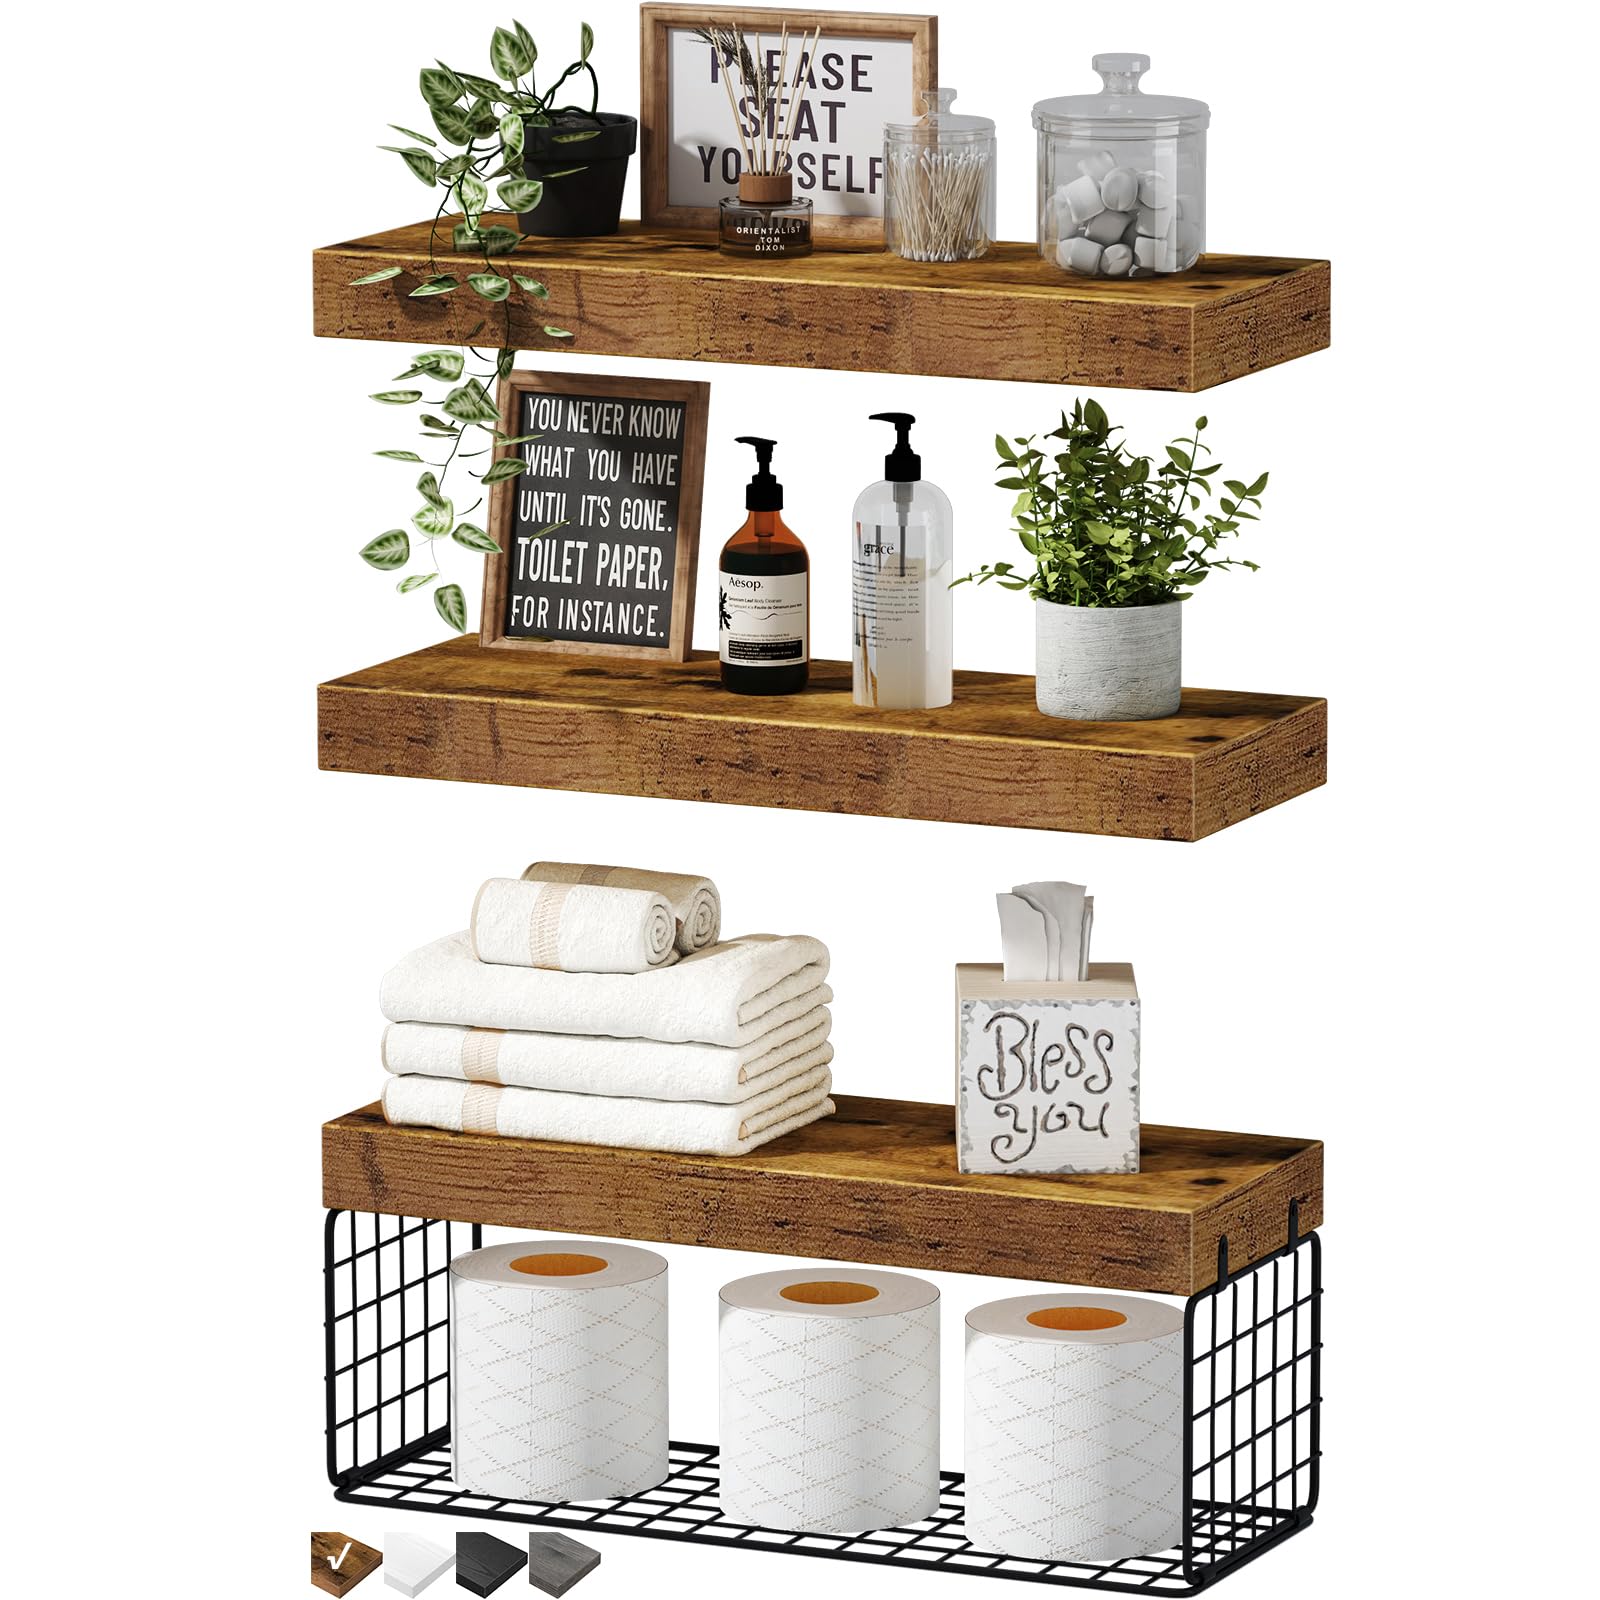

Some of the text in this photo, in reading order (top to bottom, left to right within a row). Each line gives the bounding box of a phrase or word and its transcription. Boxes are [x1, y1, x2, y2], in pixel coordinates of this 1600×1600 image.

[711, 47, 873, 93] PEASE
[738, 96, 846, 143] SEAT
[736, 226, 800, 235] ORIENTALIST
[755, 244, 785, 252] DIXON
[760, 236, 780, 244] TOM
[528, 397, 682, 440] YOU NEVER KNOW
[524, 443, 678, 486] WHAT YOU HAVE
[519, 490, 673, 533] UNTIL IT'S GONE.
[517, 537, 669, 592] TOILET PAPER,
[511, 595, 665, 638] FOR INSTANCE.
[977, 1011, 1114, 1101] Bless
[990, 1101, 1110, 1164] you
